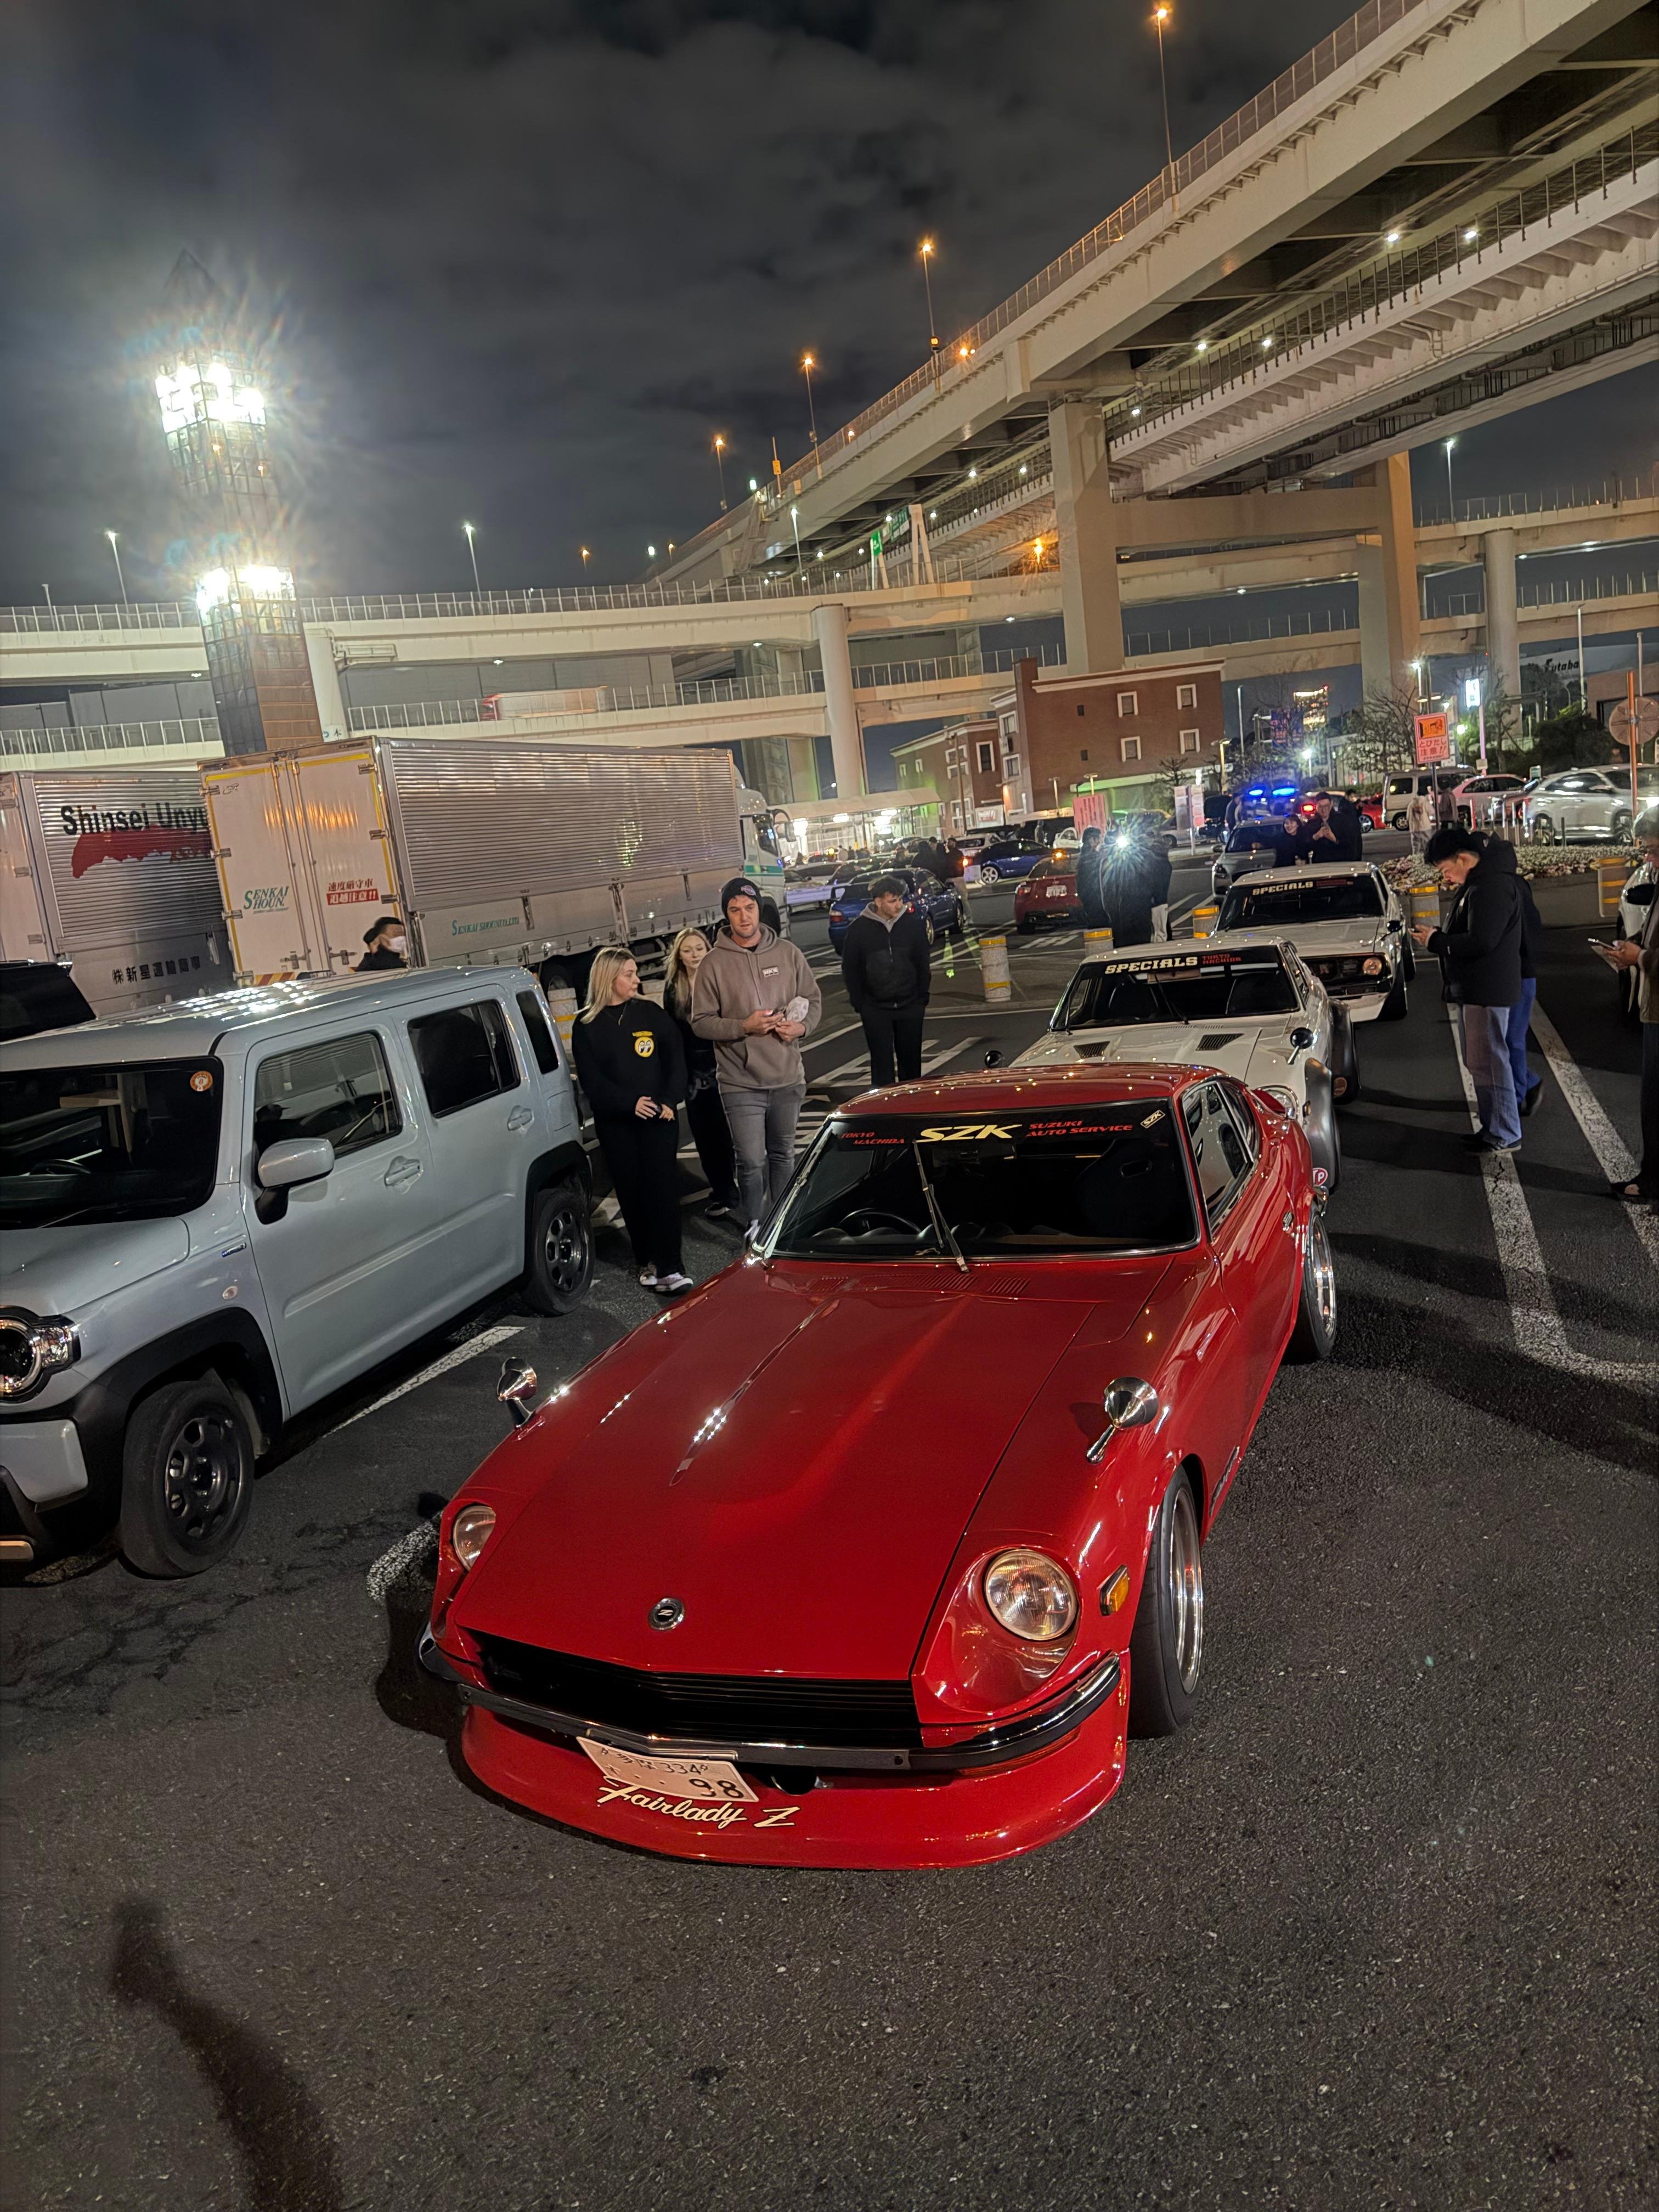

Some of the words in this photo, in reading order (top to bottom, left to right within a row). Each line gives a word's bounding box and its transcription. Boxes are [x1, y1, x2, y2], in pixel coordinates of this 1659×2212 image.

[60, 803, 150, 835] Shinsei
[1252, 881, 1313, 895] SPECIALS
[244, 886, 289, 909] SENKAI
[1105, 957, 1198, 974] SPECIALS
[1029, 1121, 1083, 1129] SUZUKI
[1069, 1125, 1133, 1133] SERVICE
[915, 1125, 1023, 1143] SZK
[659, 1762, 702, 1775] 334
[597, 1776, 747, 1829] Fairlady
[753, 1806, 800, 1827] Z
